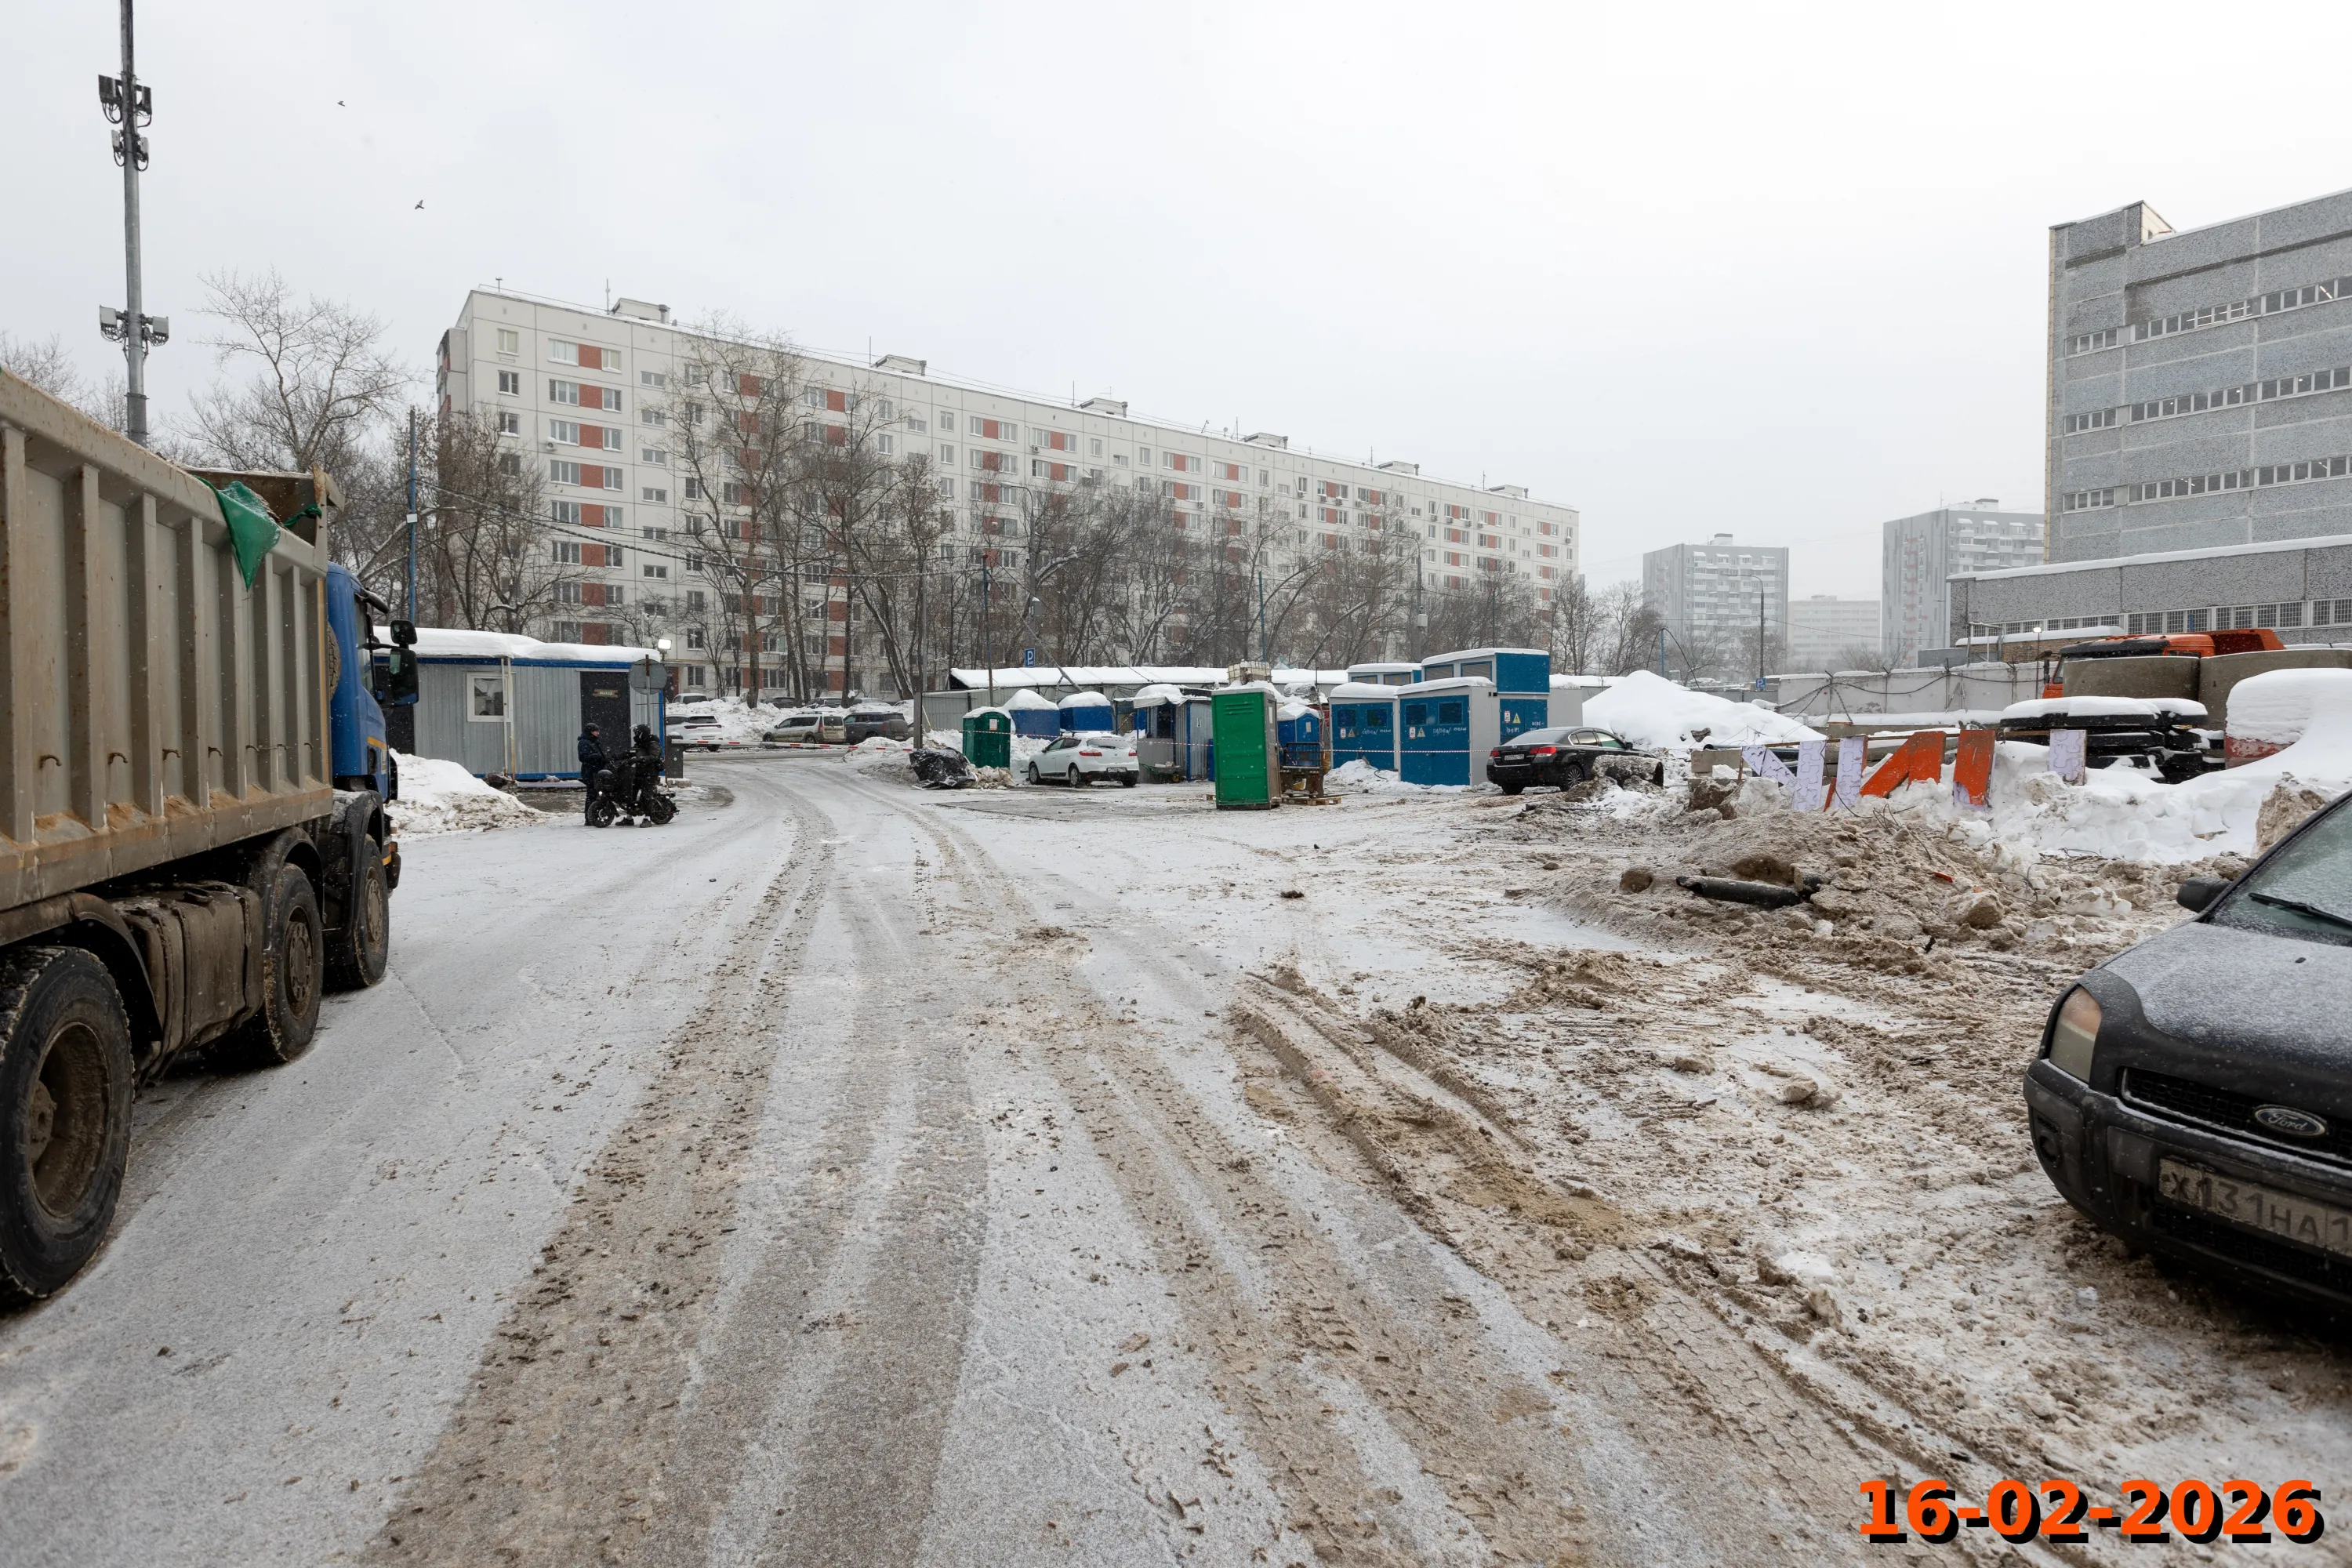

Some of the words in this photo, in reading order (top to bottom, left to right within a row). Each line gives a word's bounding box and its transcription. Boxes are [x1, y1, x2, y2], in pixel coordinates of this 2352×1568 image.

[1027, 650, 1033, 666] P
[1756, 679, 1763, 688] P
[2267, 1112, 2309, 1132] Ford
